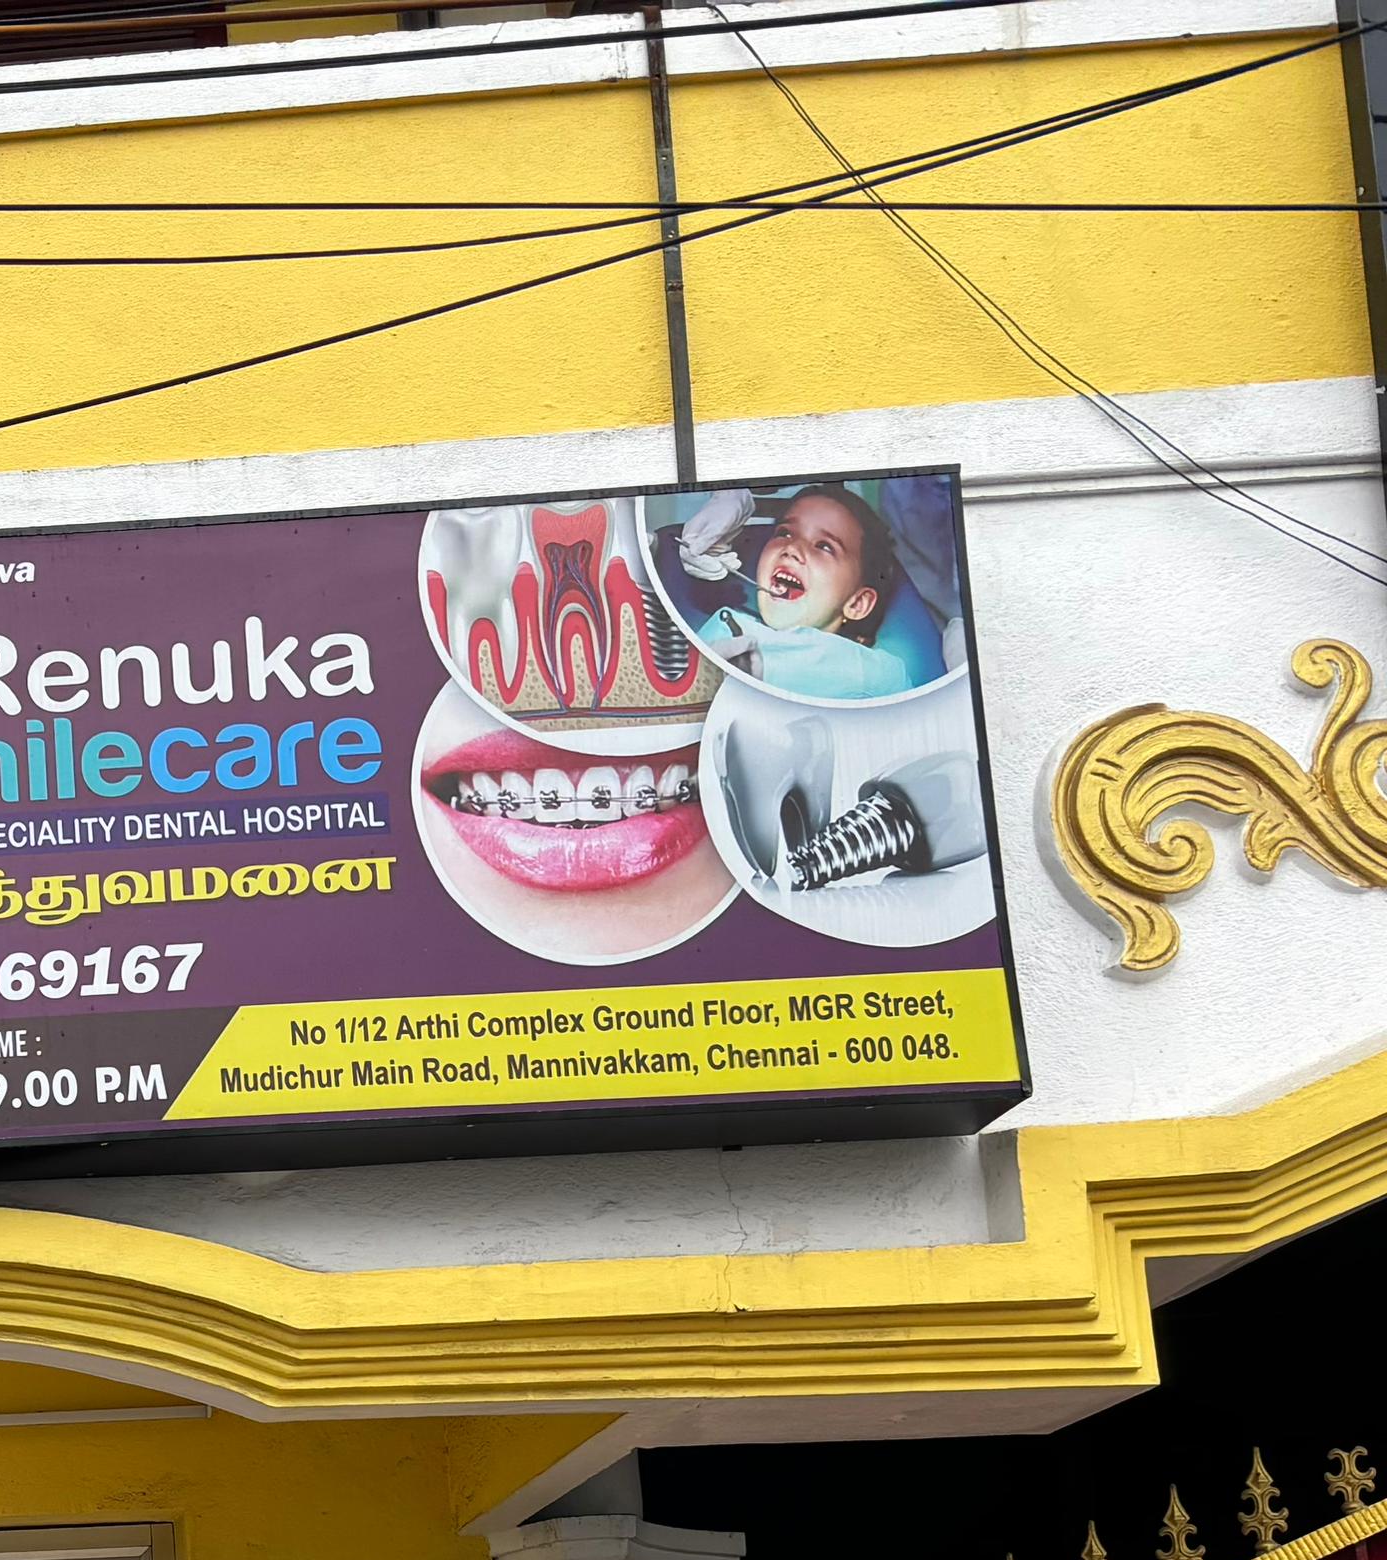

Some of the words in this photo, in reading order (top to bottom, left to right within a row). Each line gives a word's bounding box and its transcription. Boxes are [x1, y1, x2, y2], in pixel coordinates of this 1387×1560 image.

[124, 809, 237, 840] DENTAL
[244, 802, 385, 834] HOSPITAL
[290, 1020, 326, 1045] No
[335, 1016, 387, 1044] 1/12
[396, 1013, 459, 1040] Arthi
[467, 1008, 584, 1041] Complex
[593, 1002, 694, 1032] Ground
[703, 999, 780, 1028] Floor,
[789, 995, 856, 1022] MGR
[864, 989, 954, 1018] Street,
[95, 1064, 167, 1102] P.M
[220, 1062, 344, 1093] Mudichur
[352, 1060, 413, 1087] Main
[422, 1055, 499, 1085] Road,
[508, 1047, 700, 1079] Mannivakkam,
[707, 1039, 820, 1070] Chennai
[845, 1036, 893, 1063] 600
[902, 1033, 959, 1060] 048.
